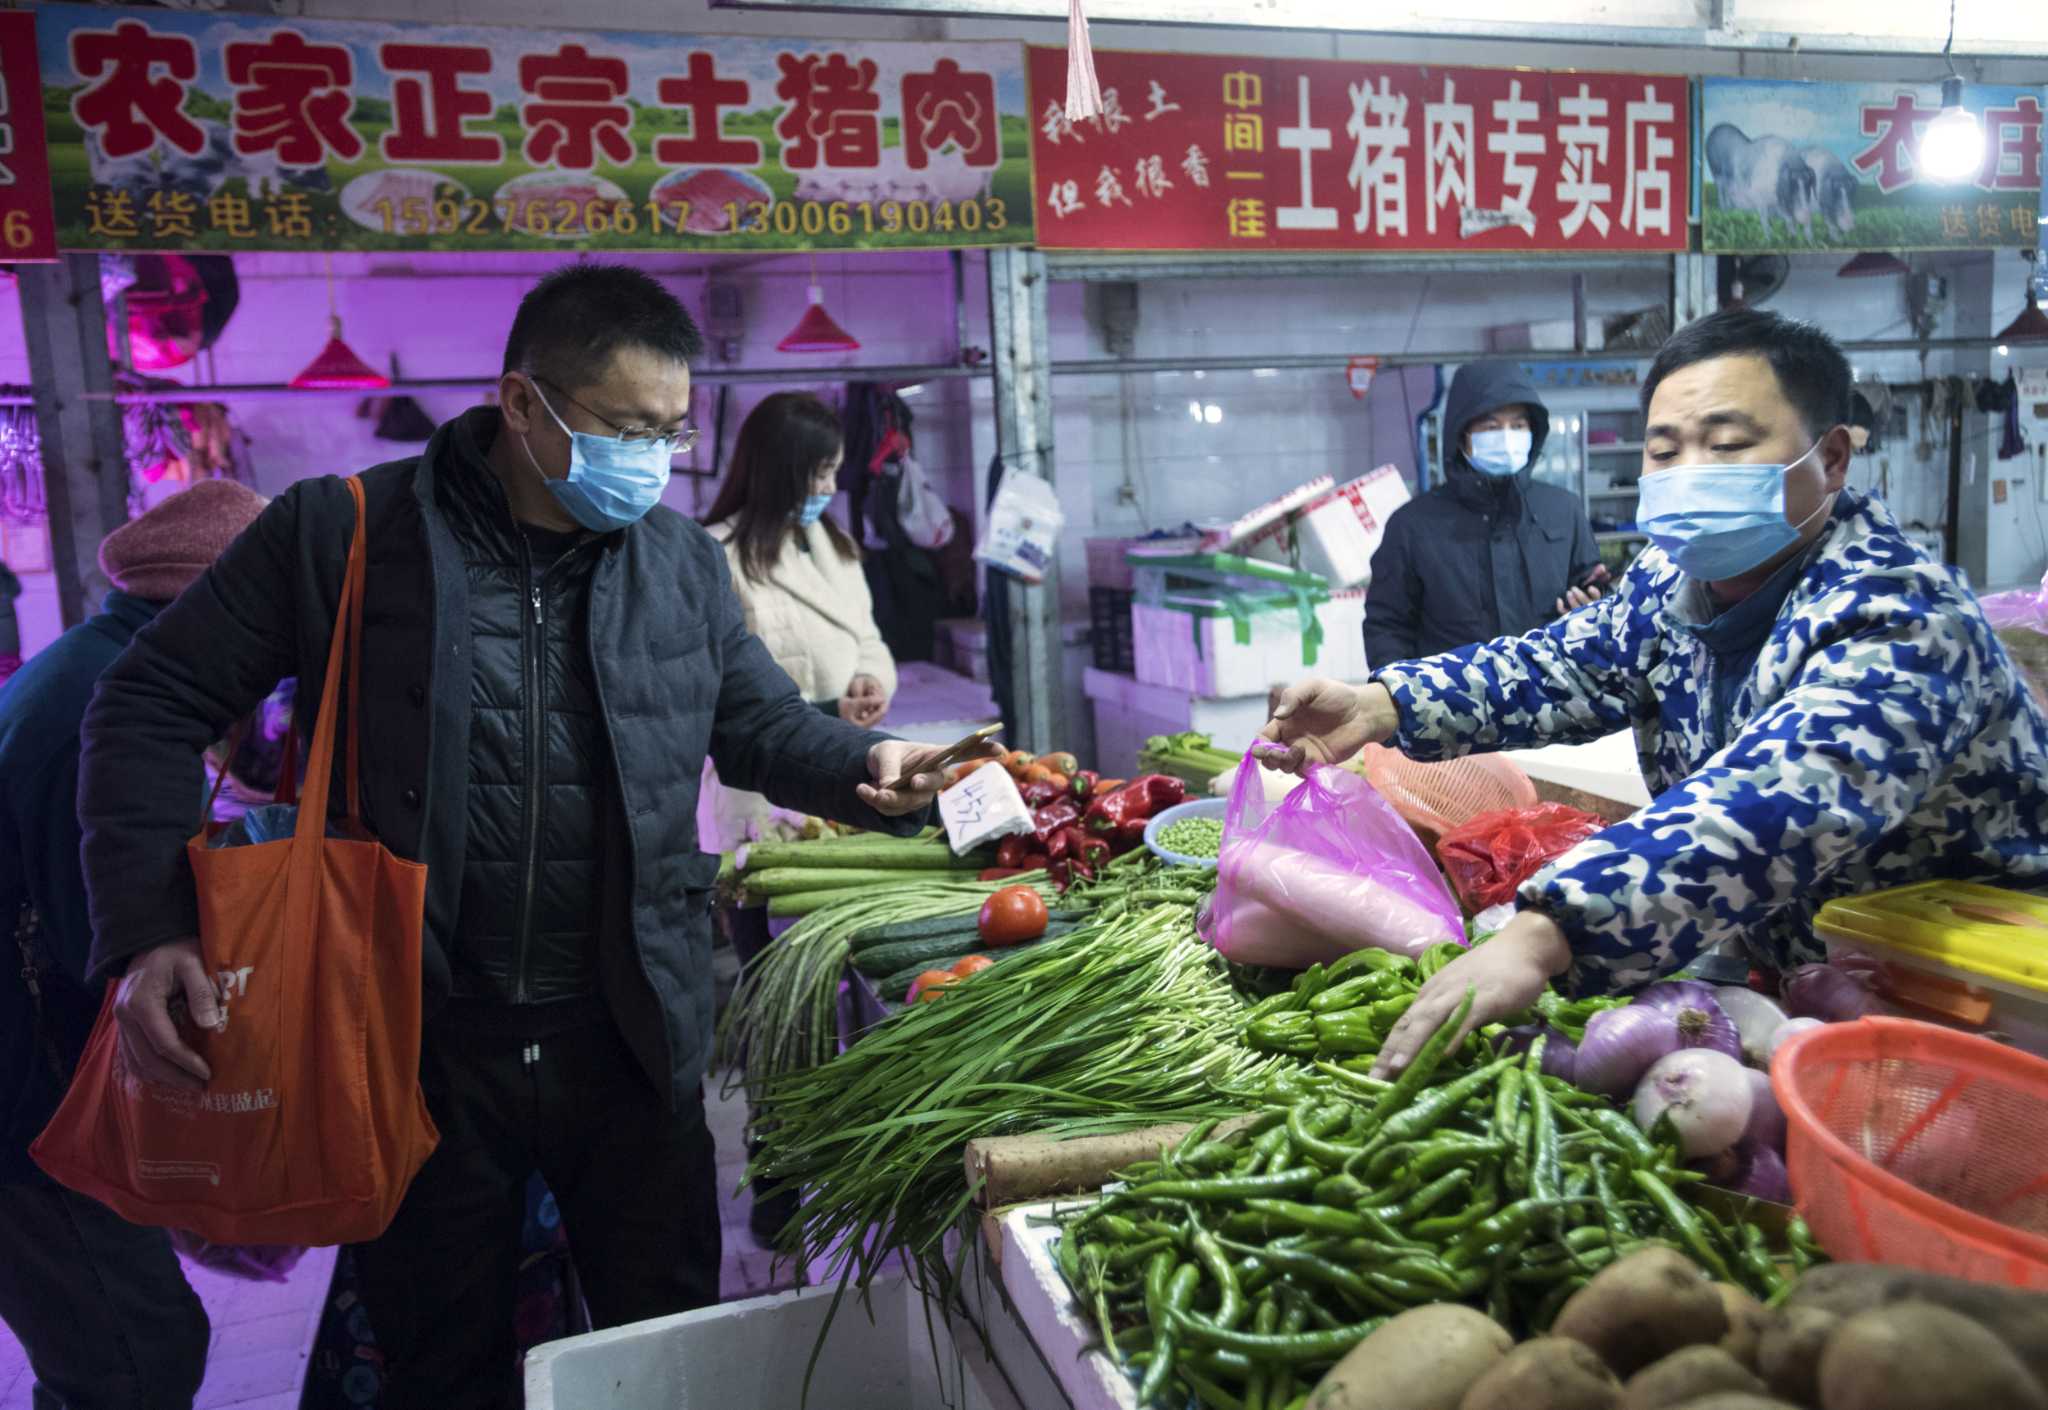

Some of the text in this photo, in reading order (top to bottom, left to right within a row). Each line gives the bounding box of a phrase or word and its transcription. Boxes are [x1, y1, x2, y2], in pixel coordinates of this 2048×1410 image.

[68, 18, 1001, 171] 农家正宗土猪肉
[1042, 79, 1182, 144] 我很土
[1048, 143, 1210, 219] 但我很香
[1222, 71, 1266, 238] 中间一佳
[1275, 74, 1675, 239] 土猪肉专卖店
[377, 198, 690, 236] 15927626617
[725, 199, 1008, 234] 13006190403
